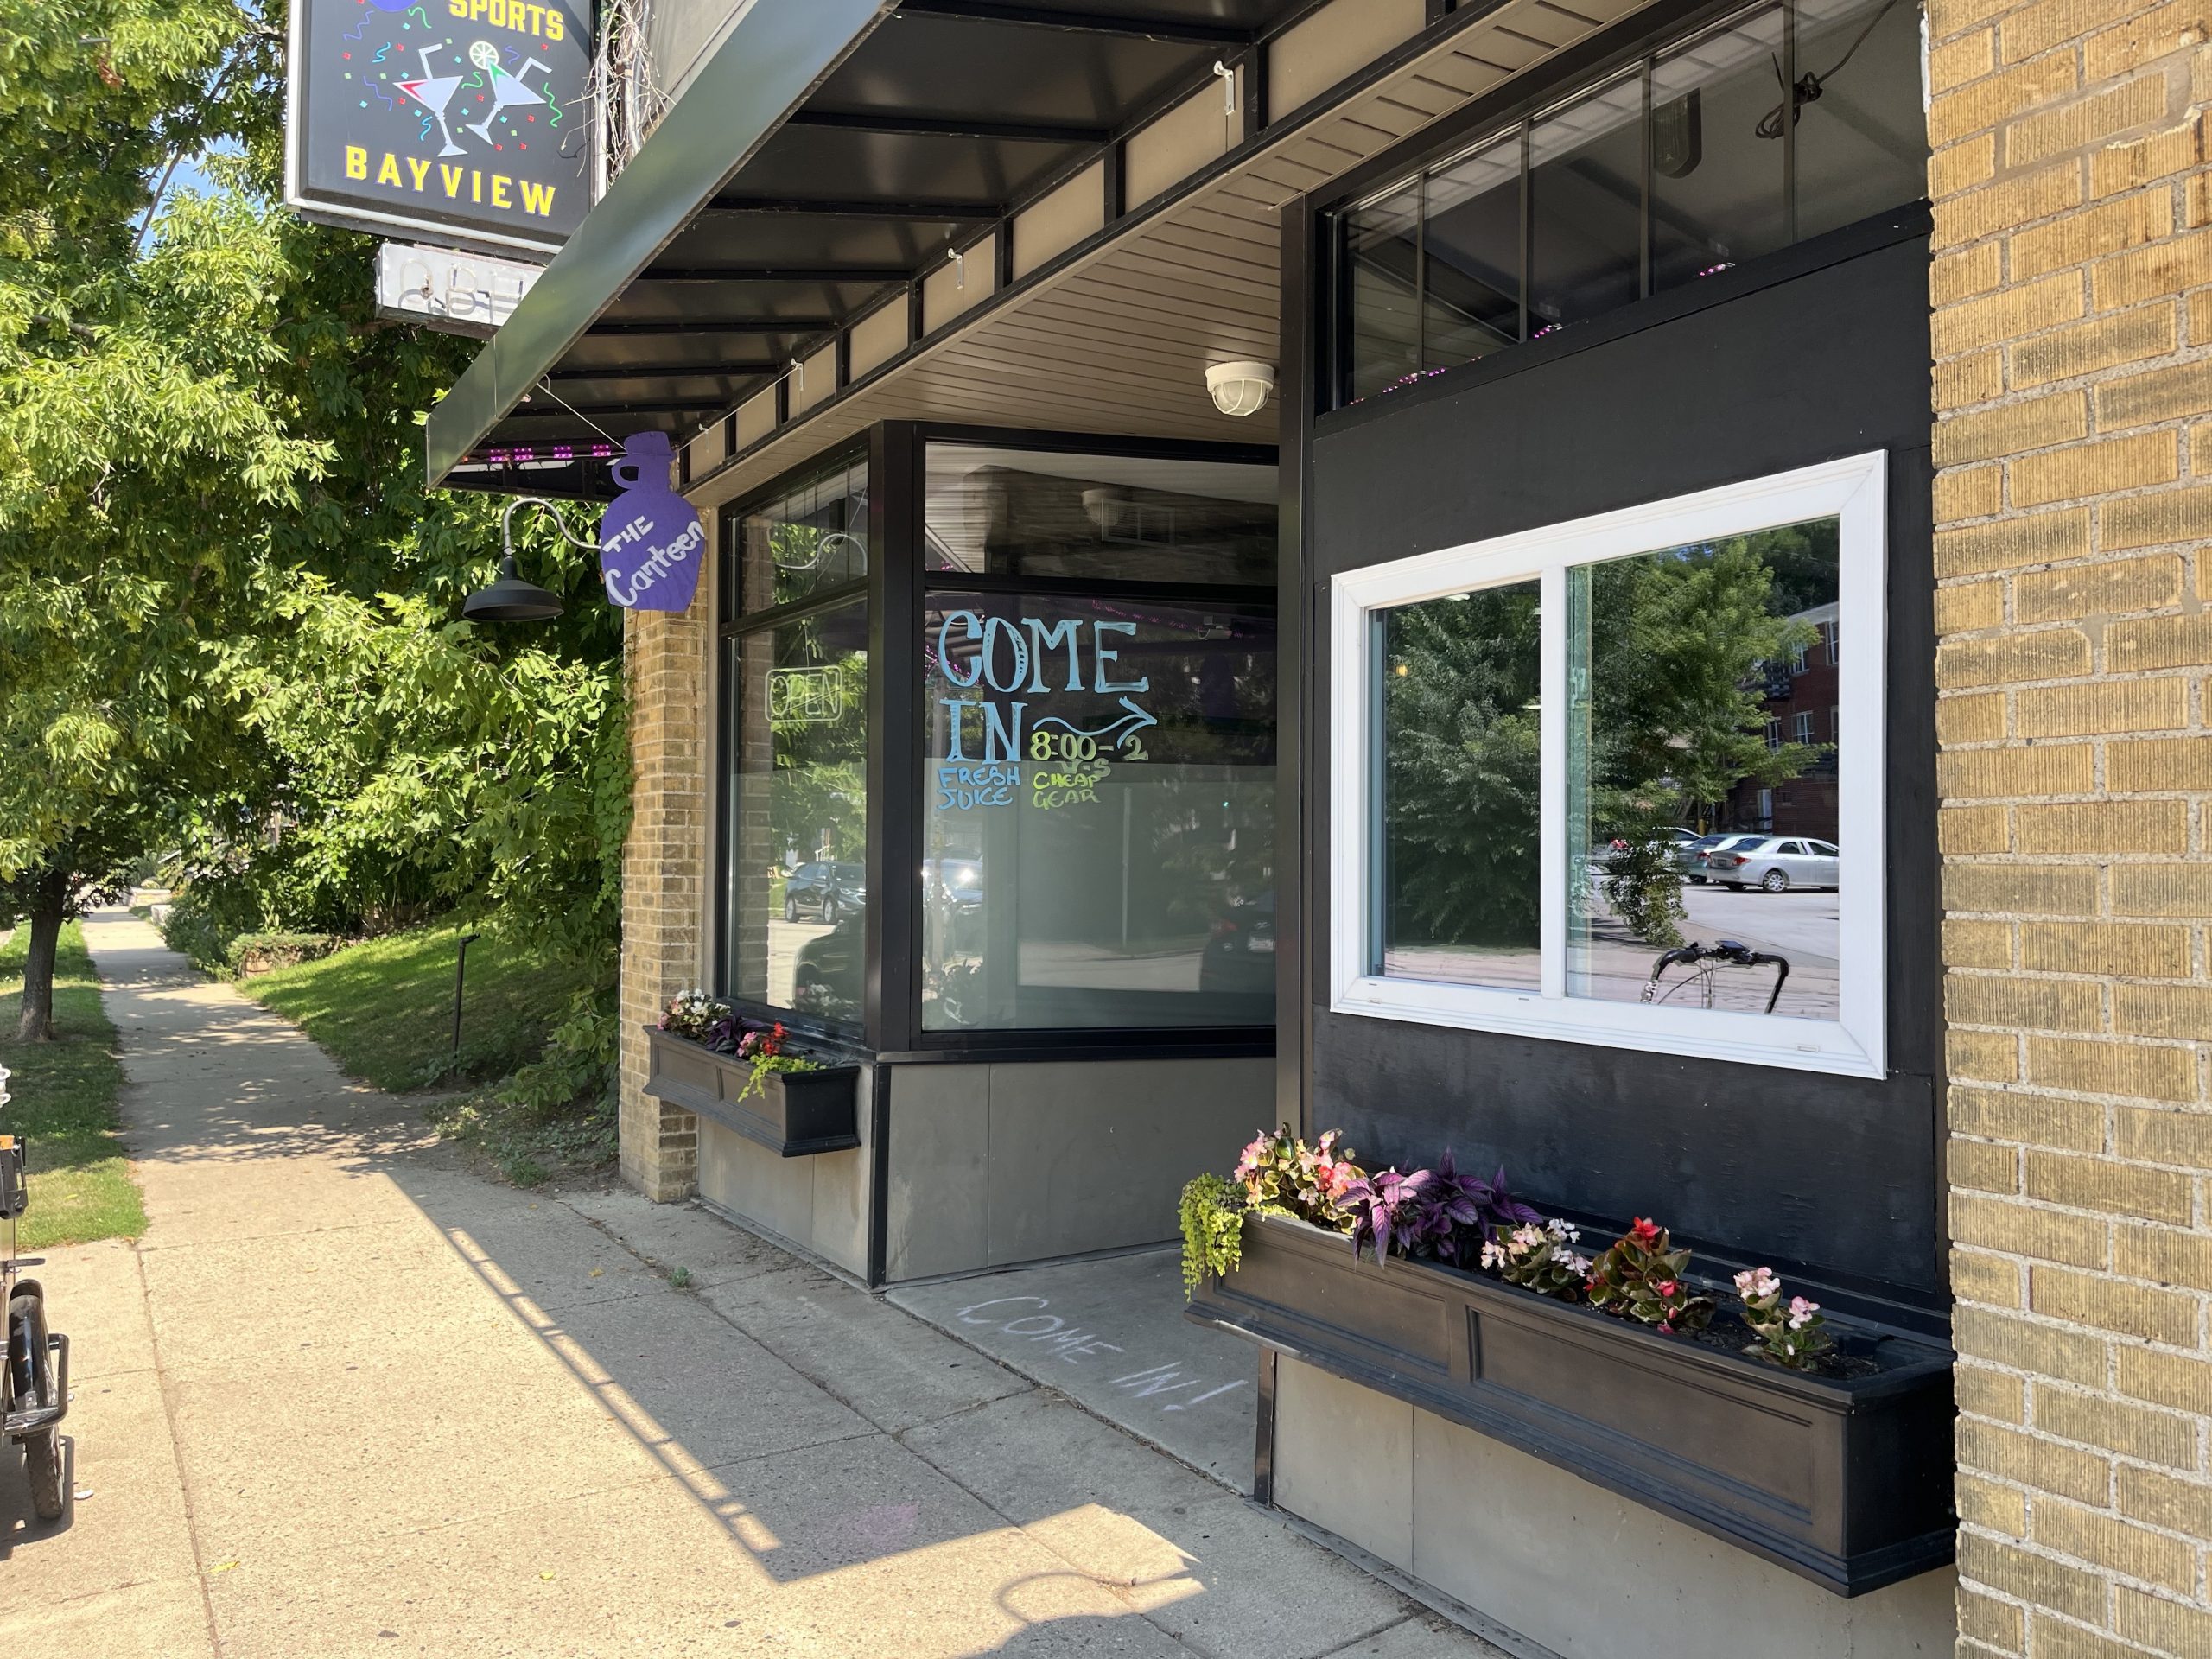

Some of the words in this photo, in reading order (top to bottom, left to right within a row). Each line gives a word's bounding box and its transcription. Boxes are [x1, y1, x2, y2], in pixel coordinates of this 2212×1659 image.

[448, 0, 564, 41] SPORTS
[343, 145, 556, 219] BAYVIEW
[602, 515, 654, 553] THE
[605, 520, 706, 607] Canteen
[938, 610, 1150, 693] COME
[770, 672, 839, 716] OPEN
[938, 698, 1028, 765] IN
[937, 786, 1014, 810] JUICE
[938, 766, 1021, 788] FRESH
[1033, 771, 1102, 790] CHEAP
[1033, 788, 1102, 810] GEAR
[955, 1295, 1126, 1365] COME
[1108, 1360, 1249, 1412] IN!
